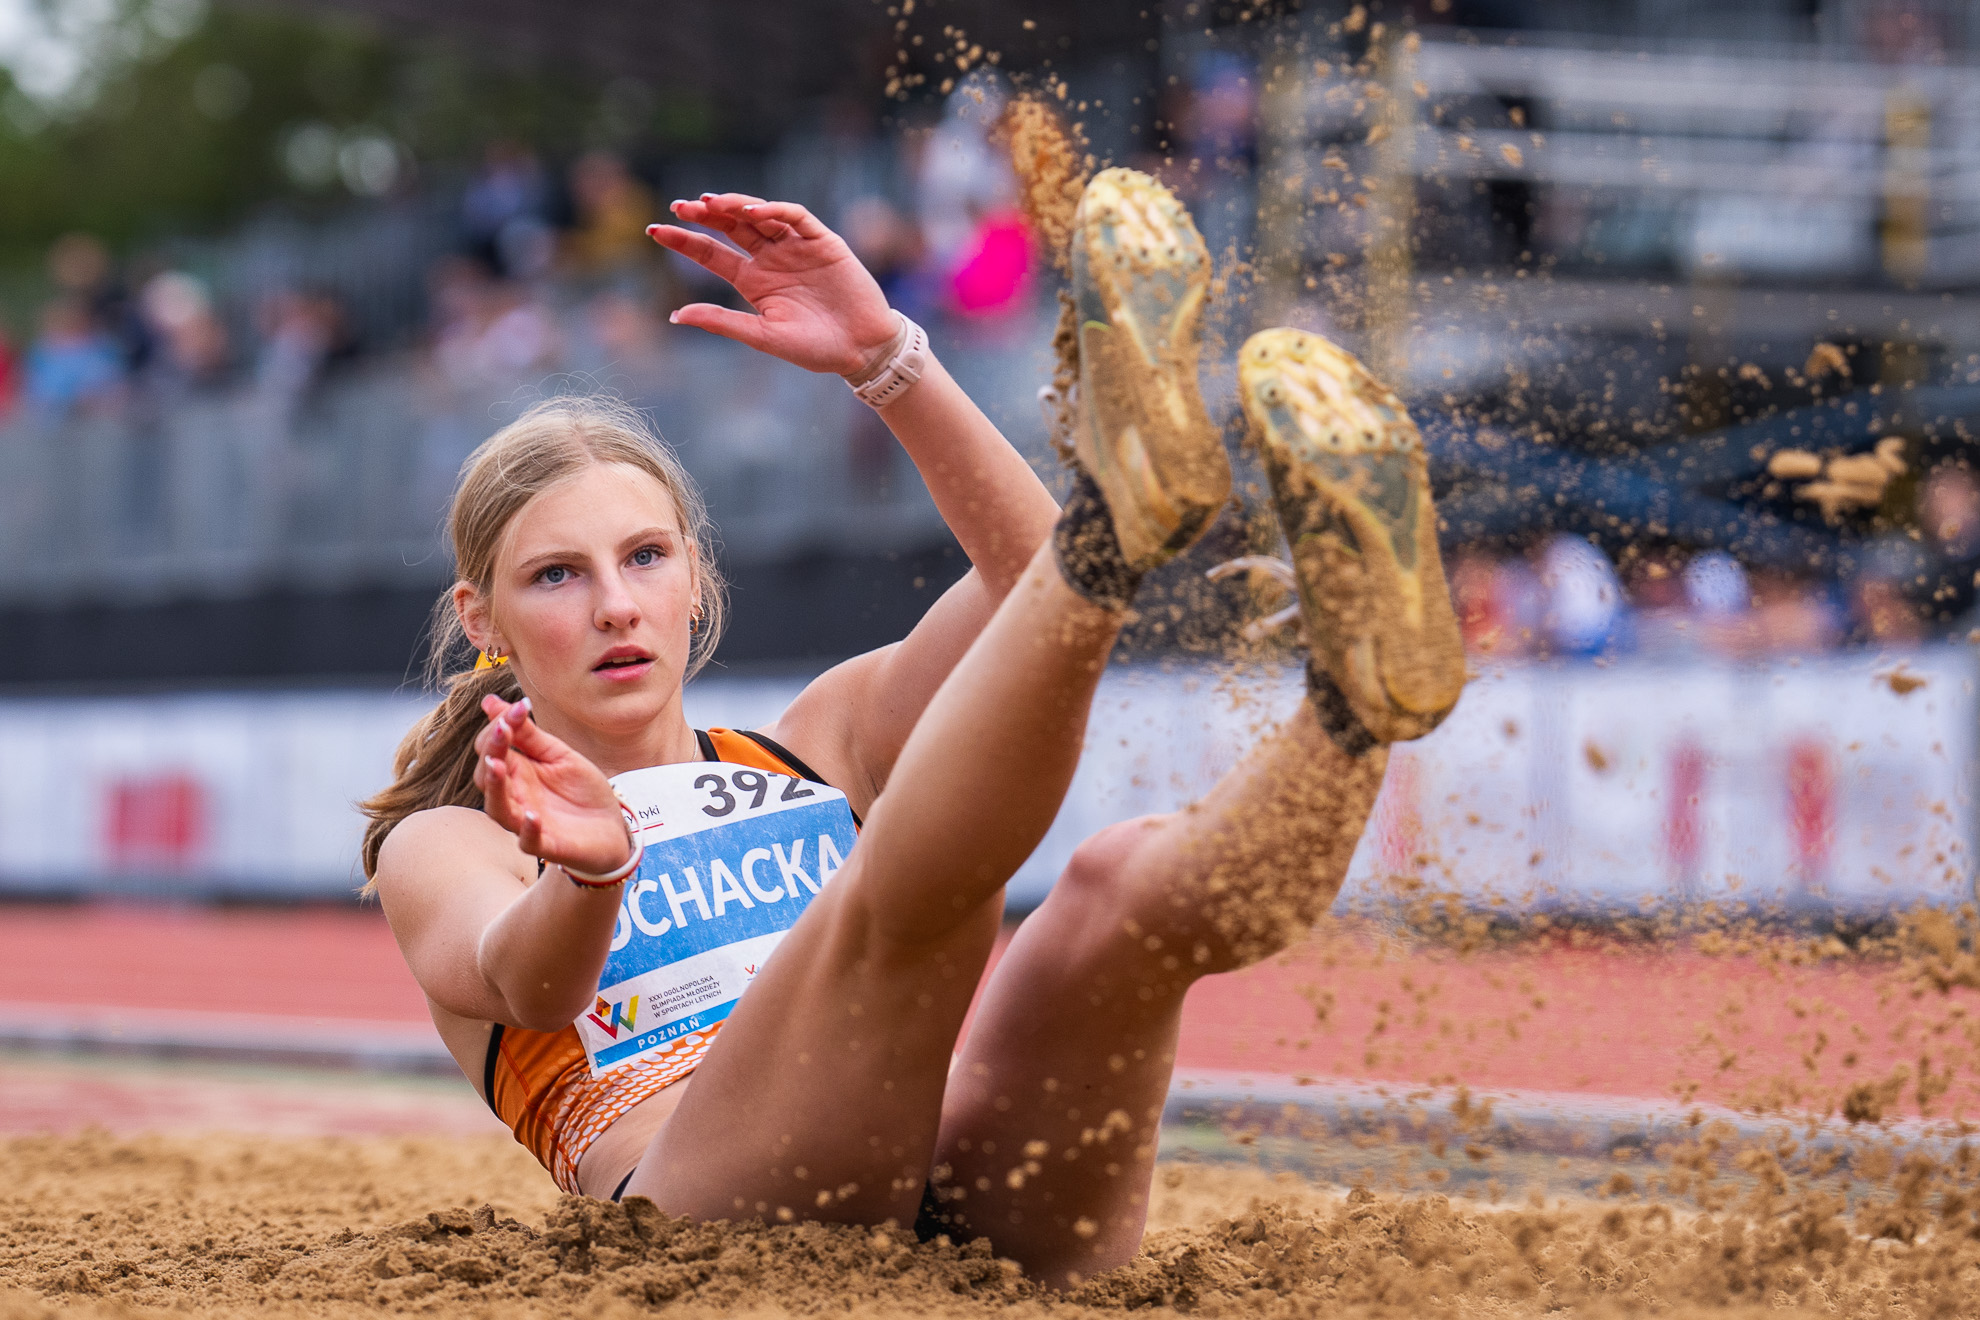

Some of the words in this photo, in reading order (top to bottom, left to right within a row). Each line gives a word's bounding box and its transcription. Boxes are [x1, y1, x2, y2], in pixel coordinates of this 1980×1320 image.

[694, 770, 815, 817] 392
[648, 993, 663, 1003] XXXI
[663, 975, 714, 997] OGÓLNOPOLSKA
[651, 994, 686, 1011] OLIMPIADA
[686, 981, 720, 997] MŁODZIEŻY
[661, 999, 694, 1016] SPORTACH
[694, 989, 722, 1004] LETNICH
[638, 1016, 700, 1049] POZNAŃ
